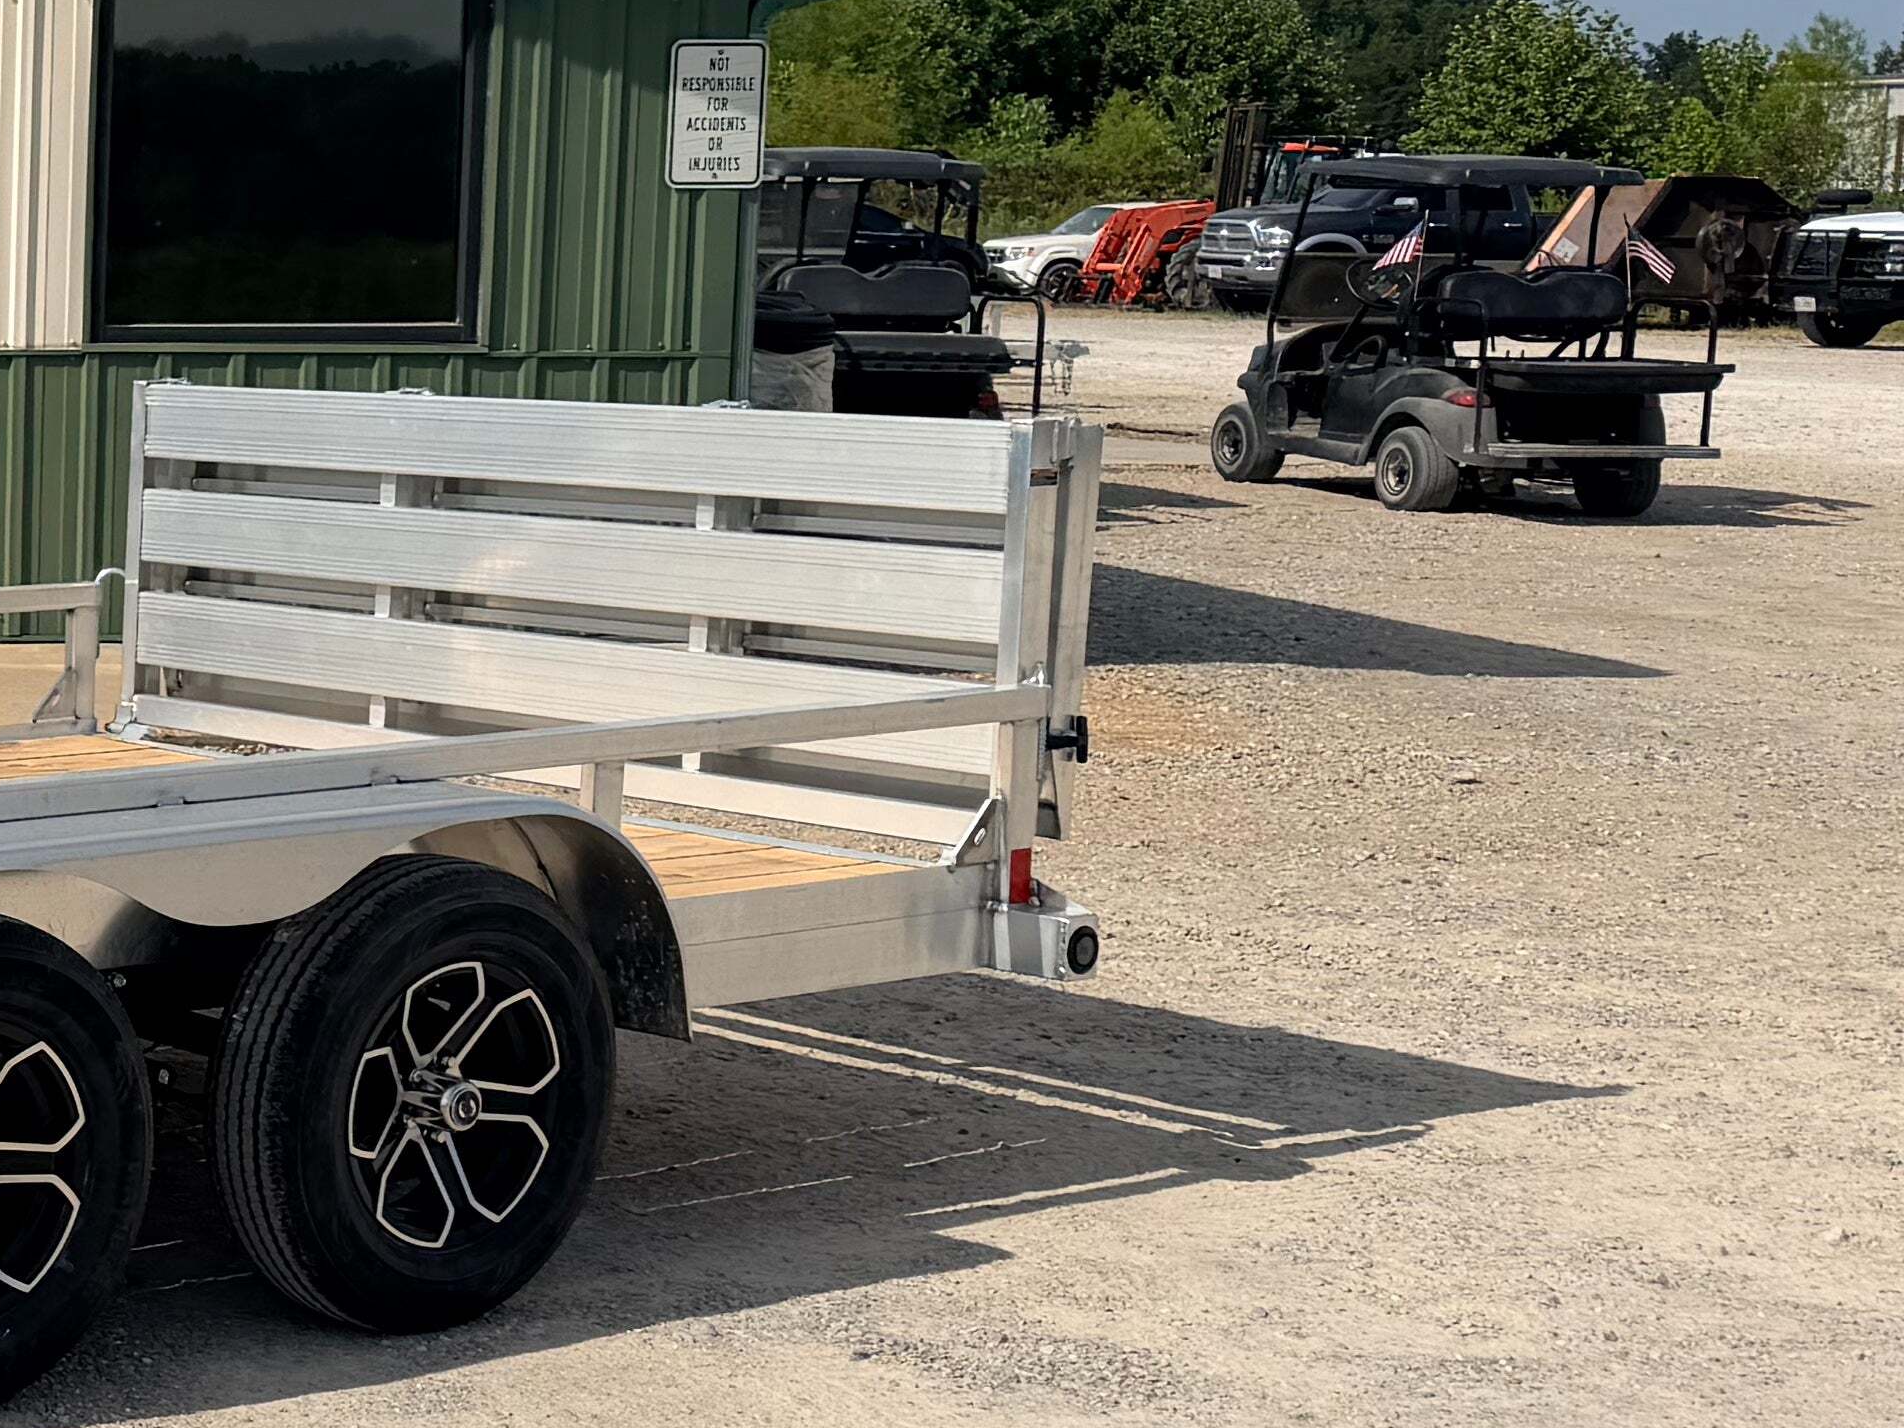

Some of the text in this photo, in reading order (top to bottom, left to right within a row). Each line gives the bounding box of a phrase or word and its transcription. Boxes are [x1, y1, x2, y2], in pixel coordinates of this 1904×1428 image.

[709, 57, 731, 71] NOT
[682, 77, 756, 92] RESPONSIBLE
[706, 96, 729, 112] FOR
[686, 117, 747, 132] ACCIDENTS
[708, 137, 723, 151] OR
[688, 156, 741, 172] INJURIES
